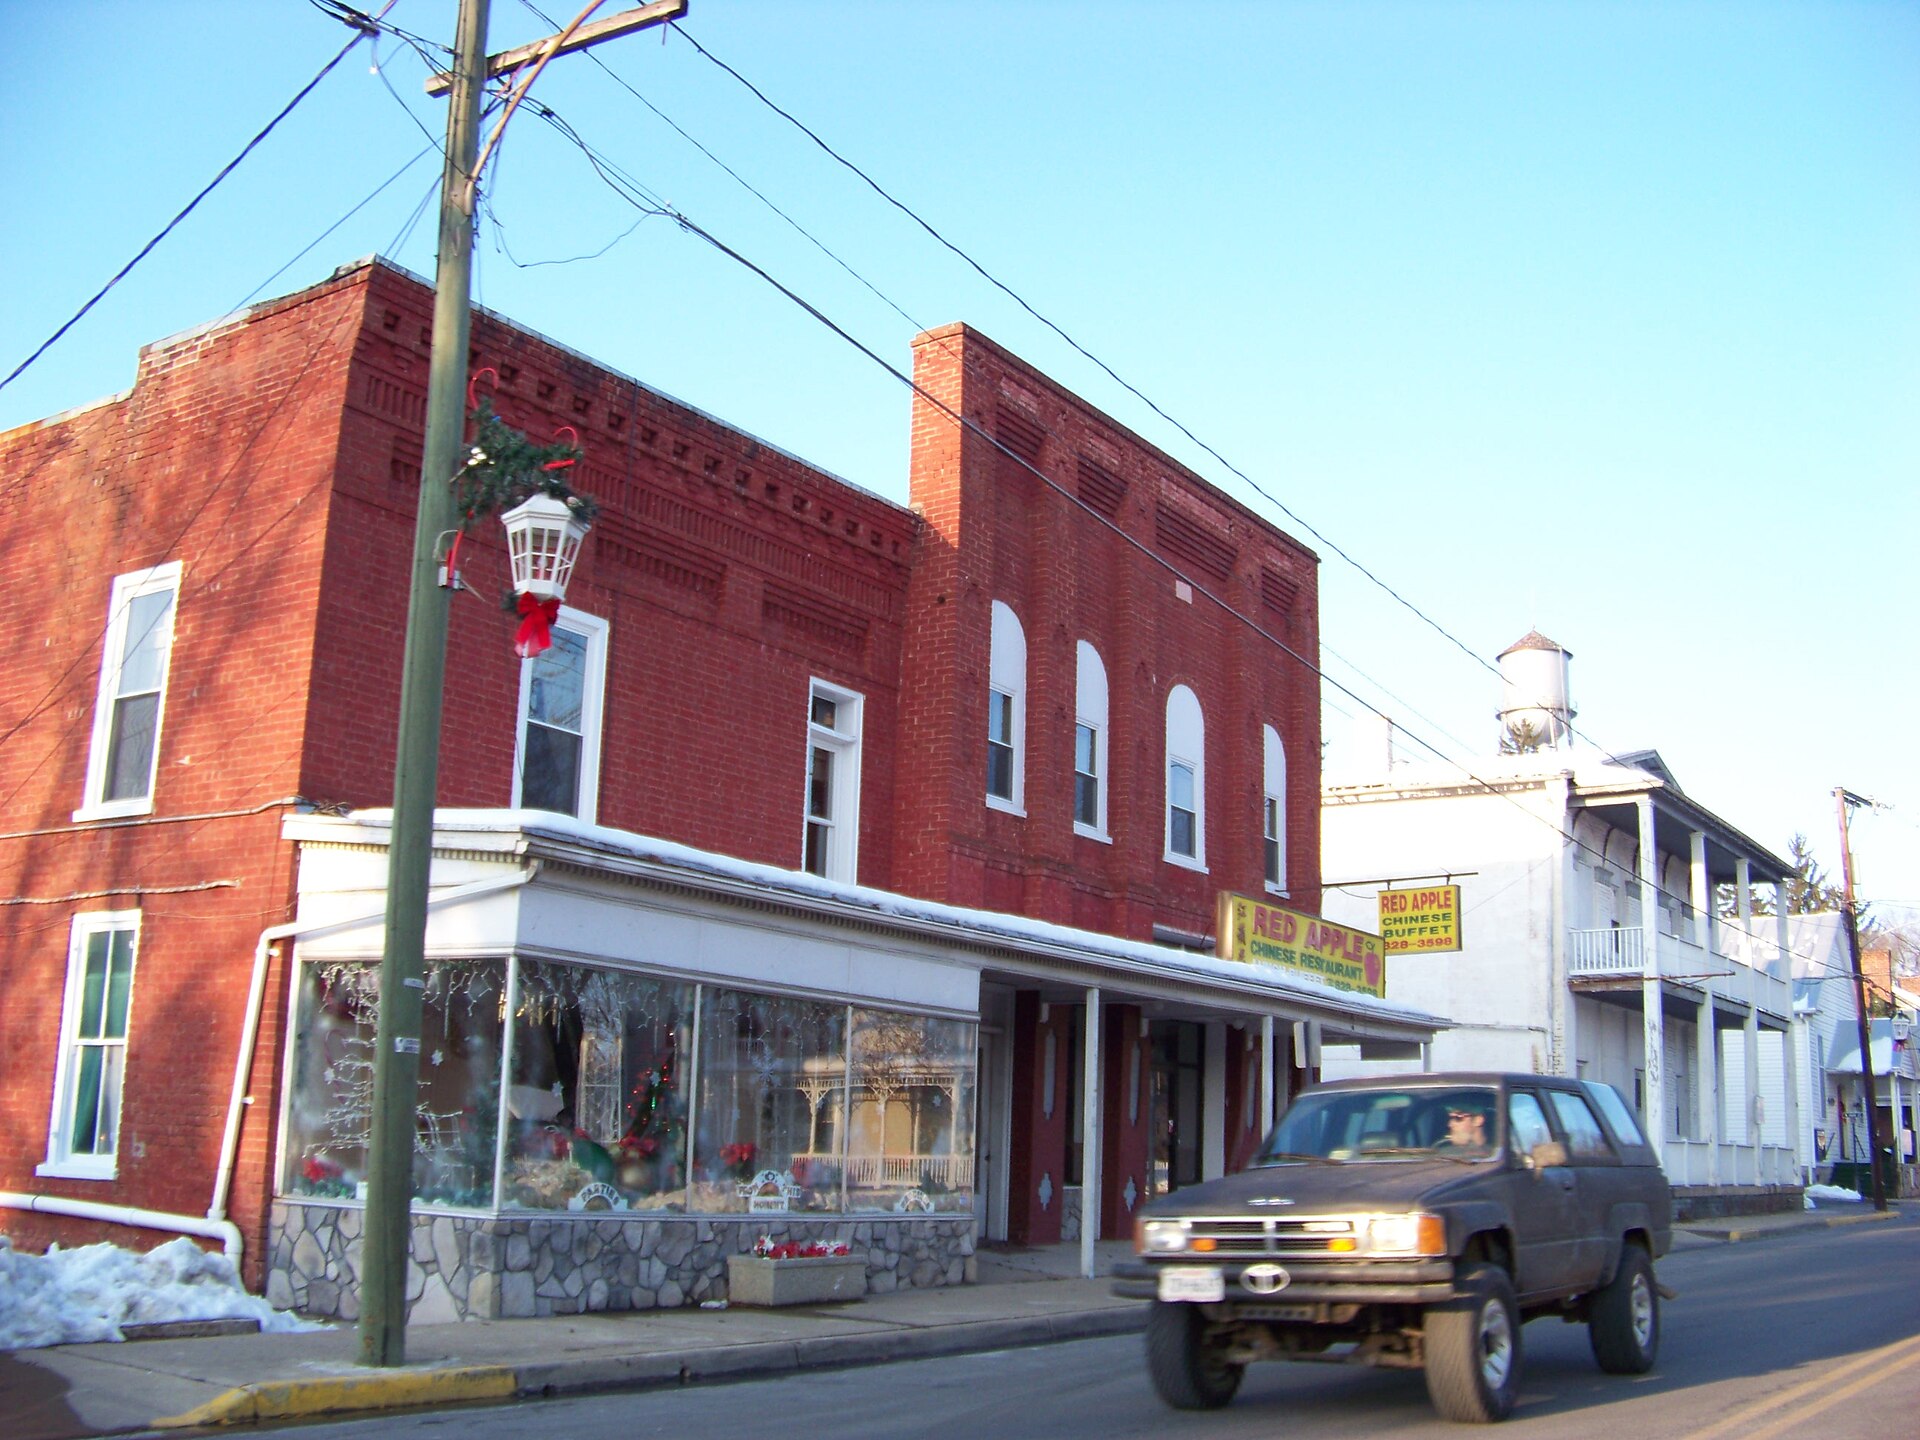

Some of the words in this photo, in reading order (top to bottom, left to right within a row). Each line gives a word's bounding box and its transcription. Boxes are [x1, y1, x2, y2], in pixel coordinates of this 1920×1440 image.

[1381, 894, 1407, 914] RED
[1411, 890, 1452, 911] APPLE
[1382, 912, 1452, 926] CHINESE
[1252, 905, 1297, 944] RED
[1304, 921, 1364, 963] APPLE
[1383, 925, 1452, 938] BUFFET
[1251, 940, 1296, 965] CHINESE
[1300, 953, 1363, 981] RESTAURANT
